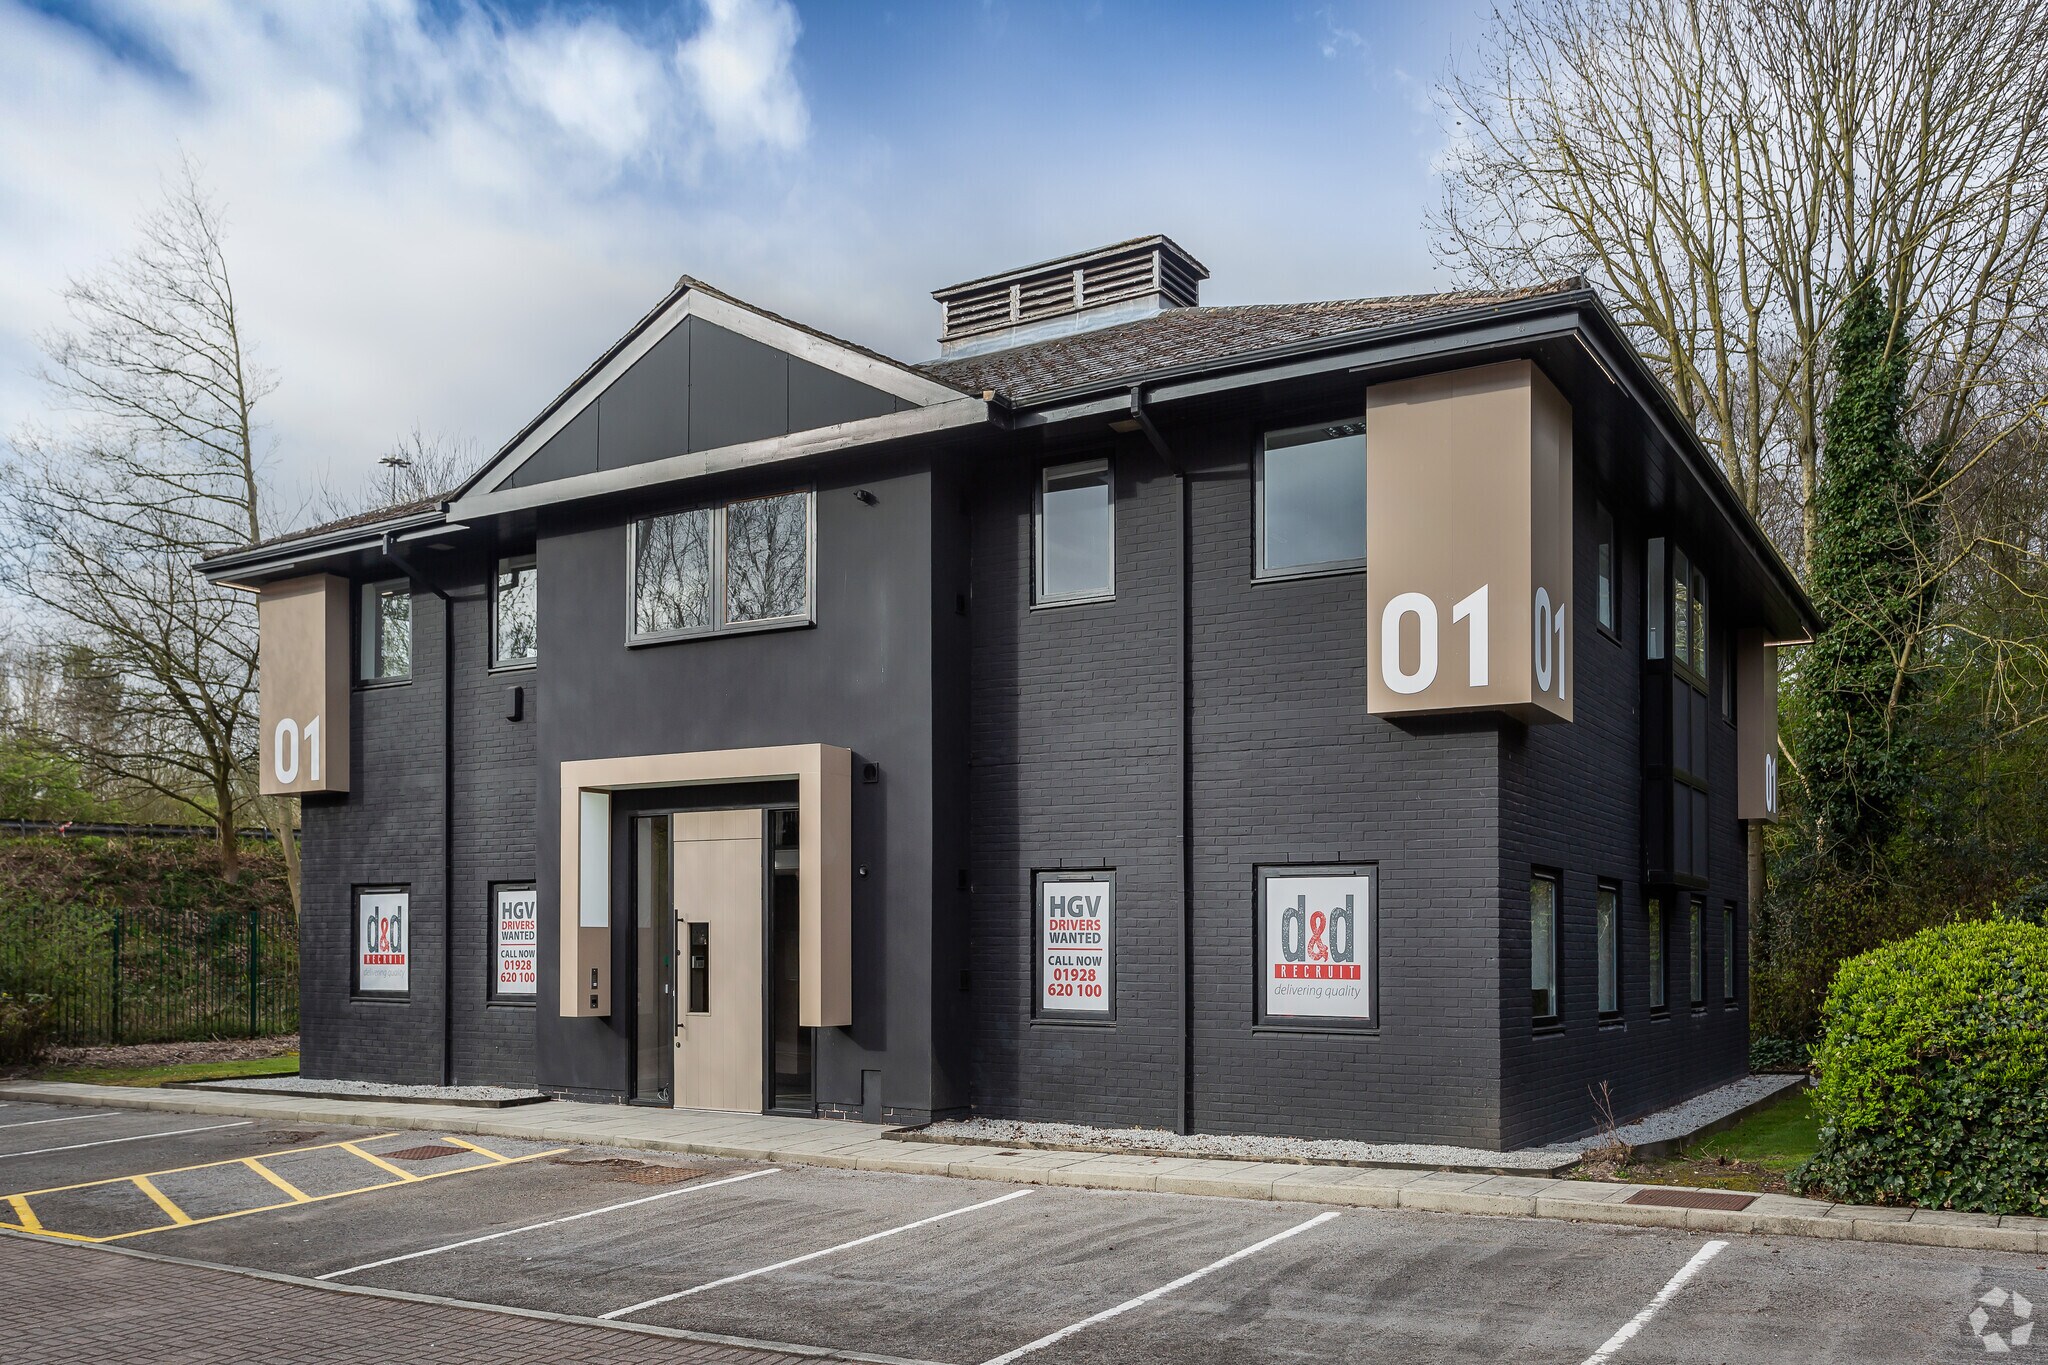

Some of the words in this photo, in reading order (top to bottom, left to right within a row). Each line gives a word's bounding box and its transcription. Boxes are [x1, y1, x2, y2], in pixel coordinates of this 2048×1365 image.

[1382, 583, 1489, 694] 01
[1535, 586, 1565, 700] 01
[275, 715, 320, 784] 01
[1766, 753, 1776, 814] 01
[502, 901, 535, 919] HGV
[1049, 895, 1102, 918] HGV
[367, 905, 402, 953] d&d
[501, 920, 535, 930] DRIVERS
[1049, 919, 1101, 931] DRIVERS
[1281, 894, 1354, 963] d&d
[501, 931, 535, 941] WANTED
[1049, 932, 1101, 944] WANTED
[366, 954, 403, 964] RECRUIT
[500, 949, 517, 958] CALL
[518, 949, 536, 958] NOW
[1048, 955, 1074, 966] CALL
[1076, 956, 1102, 966] NOW
[504, 960, 532, 970] 01928
[1280, 964, 1355, 979] RECRUIT
[500, 972, 517, 982] 620
[519, 972, 535, 982] 100
[1053, 968, 1097, 982] 01928
[1047, 983, 1073, 997] 620
[1077, 984, 1102, 998] 100
[1274, 983, 1322, 998] delivering
[1324, 984, 1361, 1000] quality
